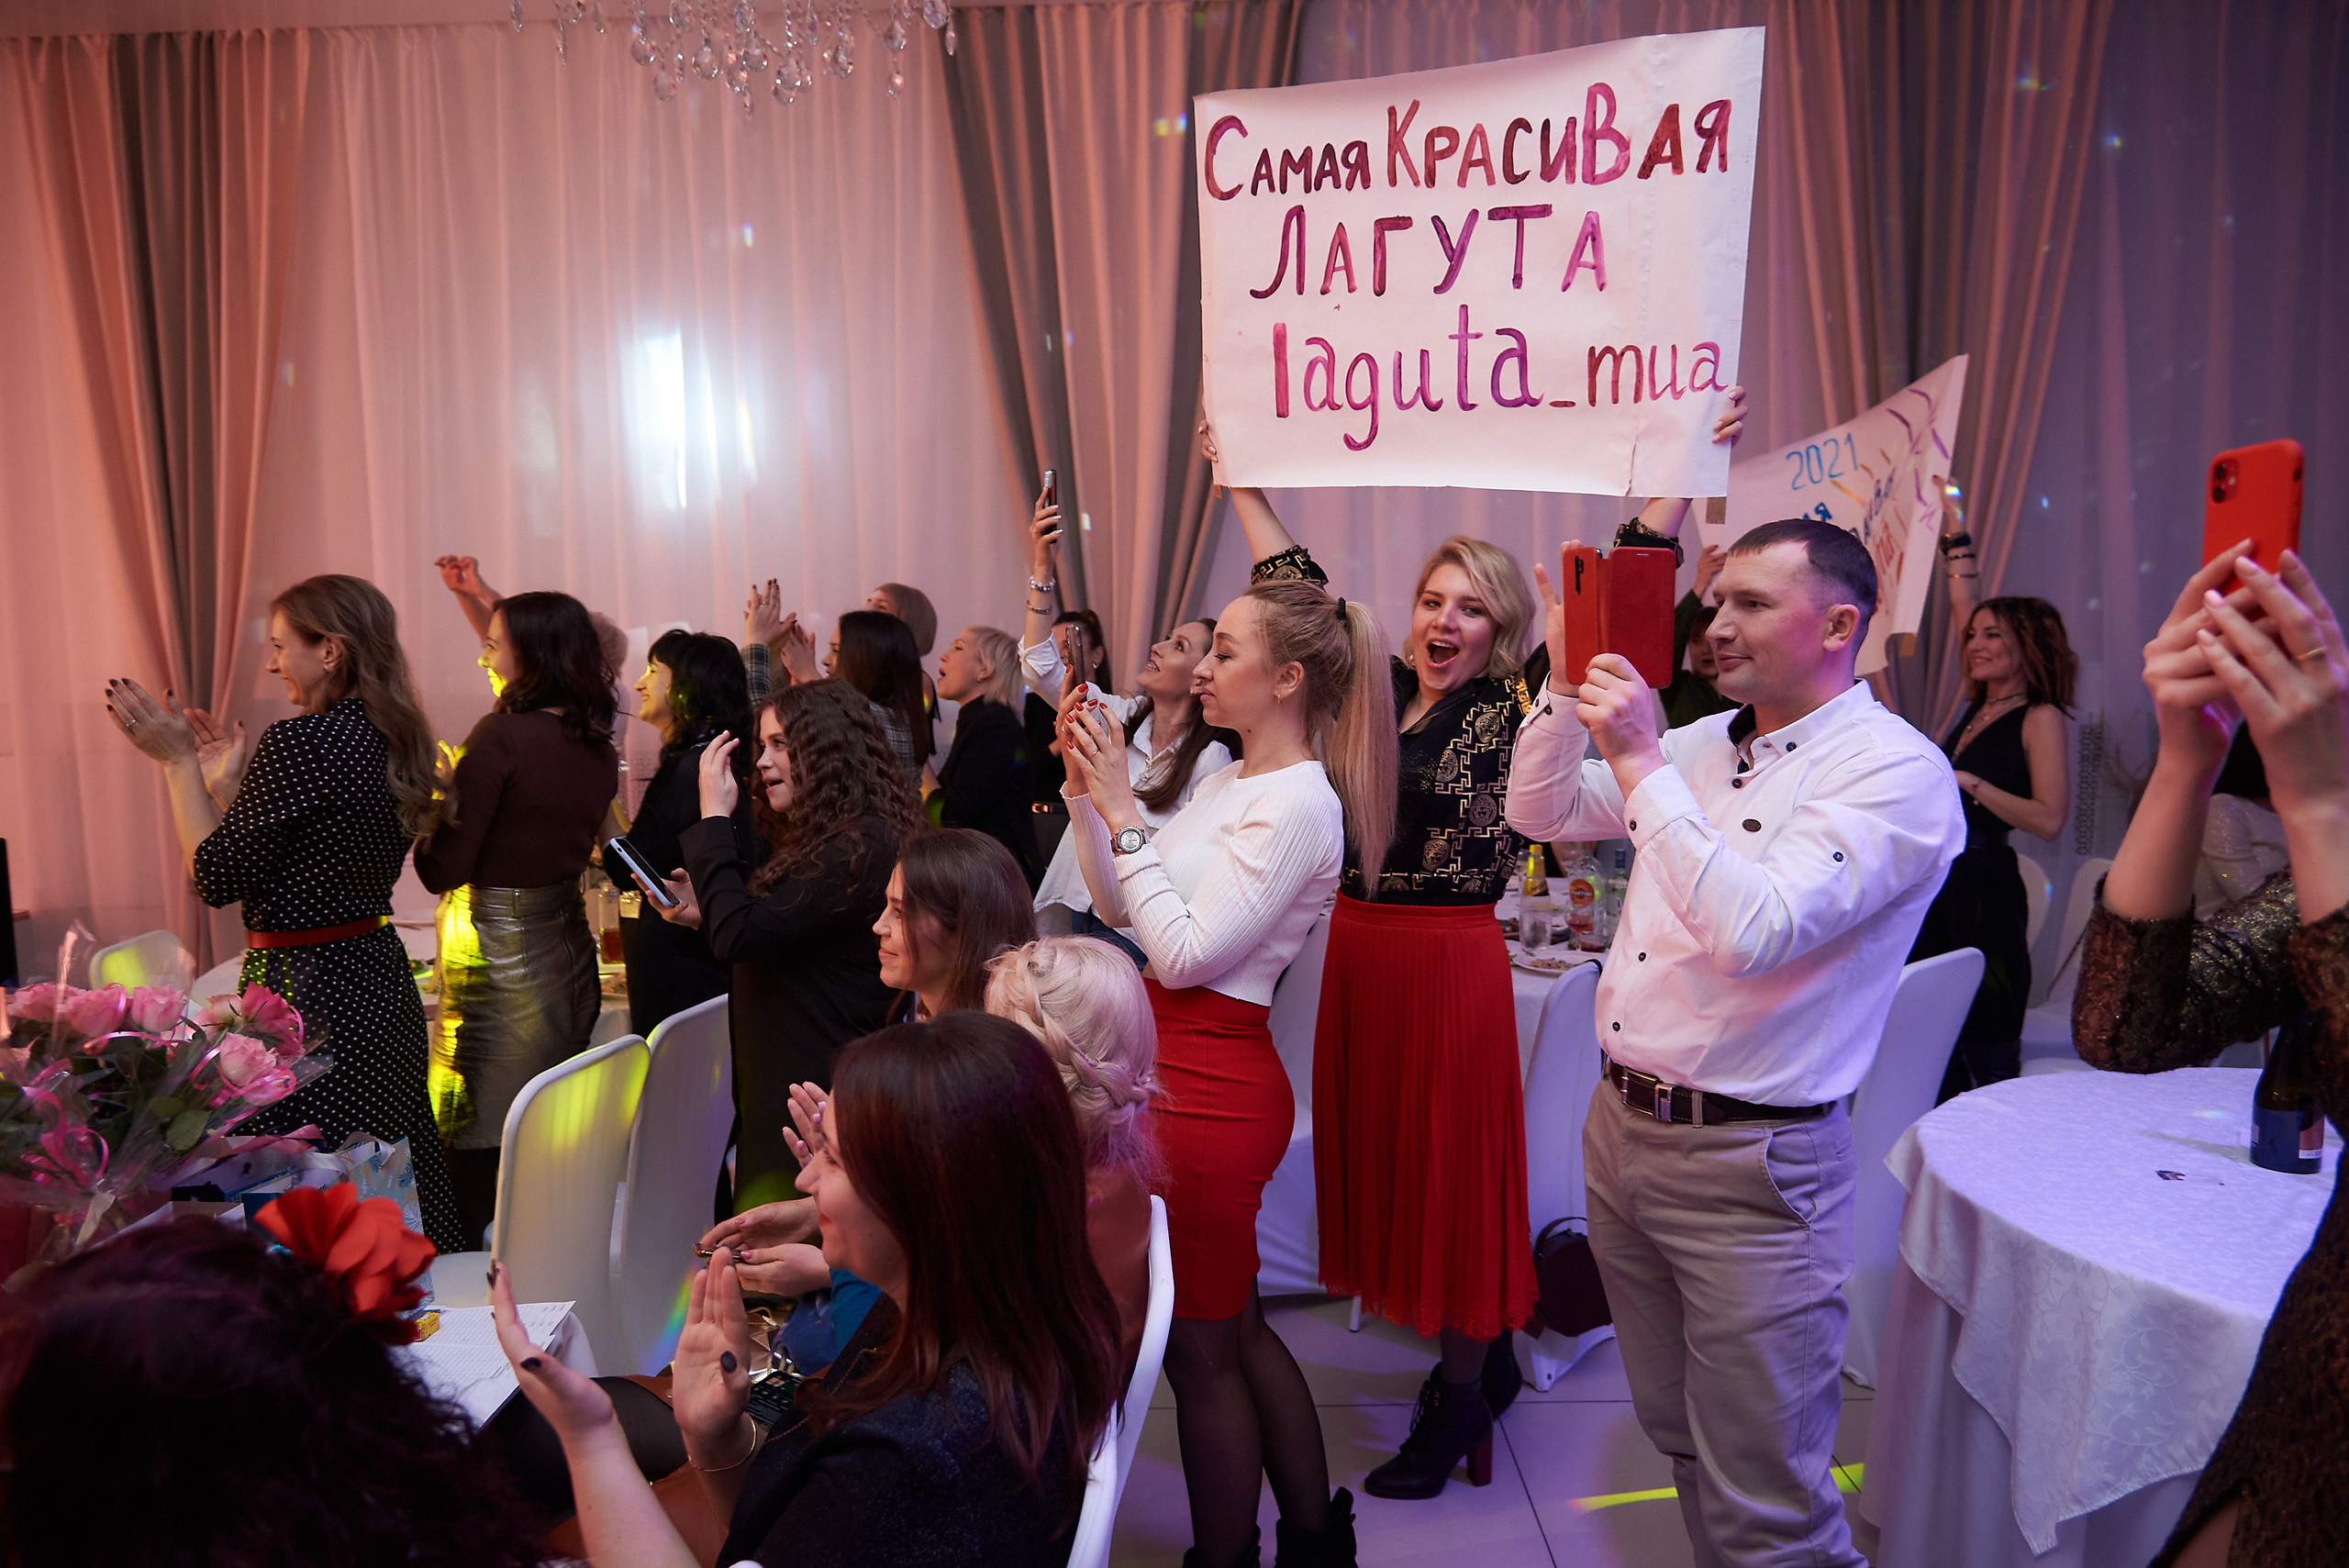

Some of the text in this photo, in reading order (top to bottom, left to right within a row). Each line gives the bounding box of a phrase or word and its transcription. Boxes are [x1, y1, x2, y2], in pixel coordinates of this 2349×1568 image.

[1249, 204, 1609, 300] ЛАГУТА
[1272, 304, 1730, 451] laguta_mua
[1786, 432, 1858, 491] 2021
